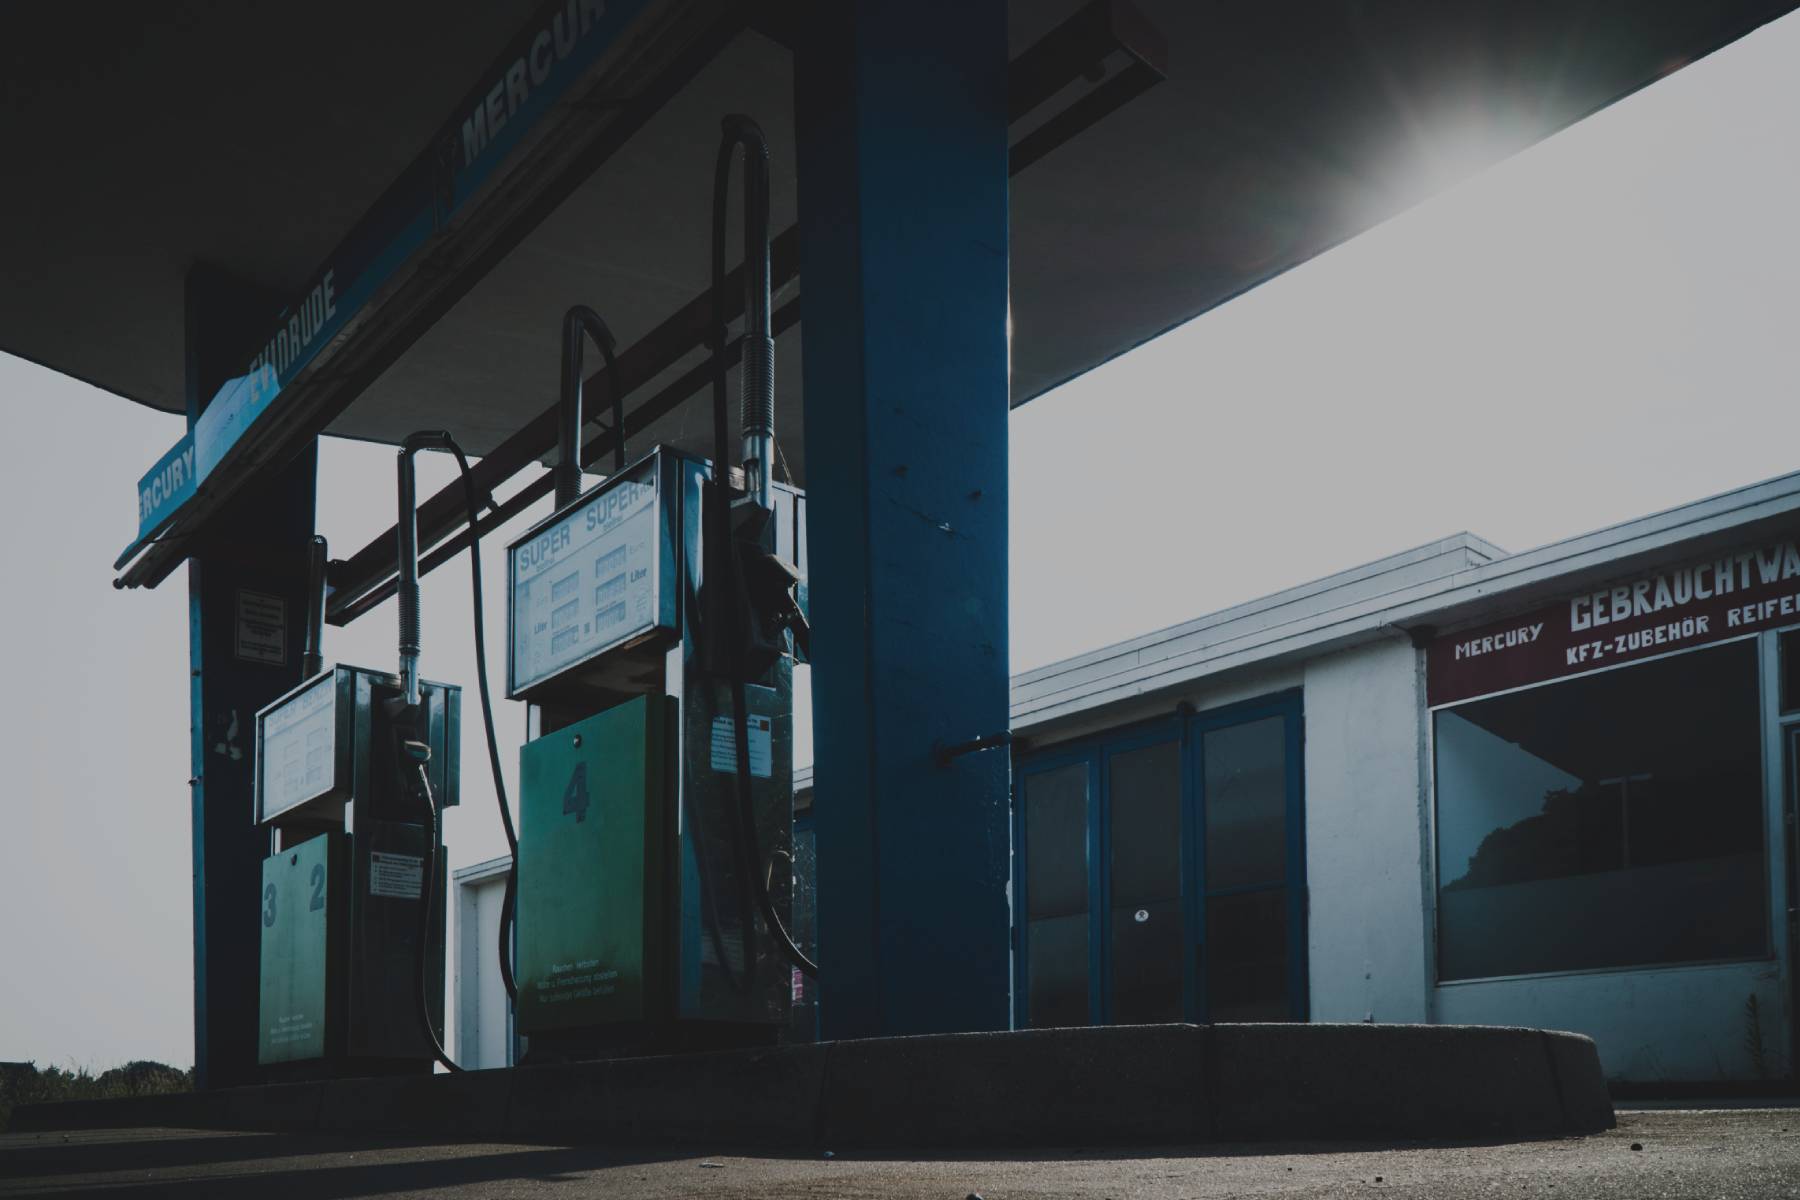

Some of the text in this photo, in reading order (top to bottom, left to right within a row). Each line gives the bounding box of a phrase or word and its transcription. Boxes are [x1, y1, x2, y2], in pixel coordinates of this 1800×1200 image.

[249, 268, 337, 406] EVINRUDE
[586, 482, 640, 532] SUPER
[519, 524, 570, 573] SUPER
[1454, 622, 1544, 660] MERCURY
[1565, 615, 1710, 665] KFZ-ZUBEHÖR
[562, 761, 590, 824] 4
[263, 883, 276, 928] 3
[309, 863, 324, 912] 2
